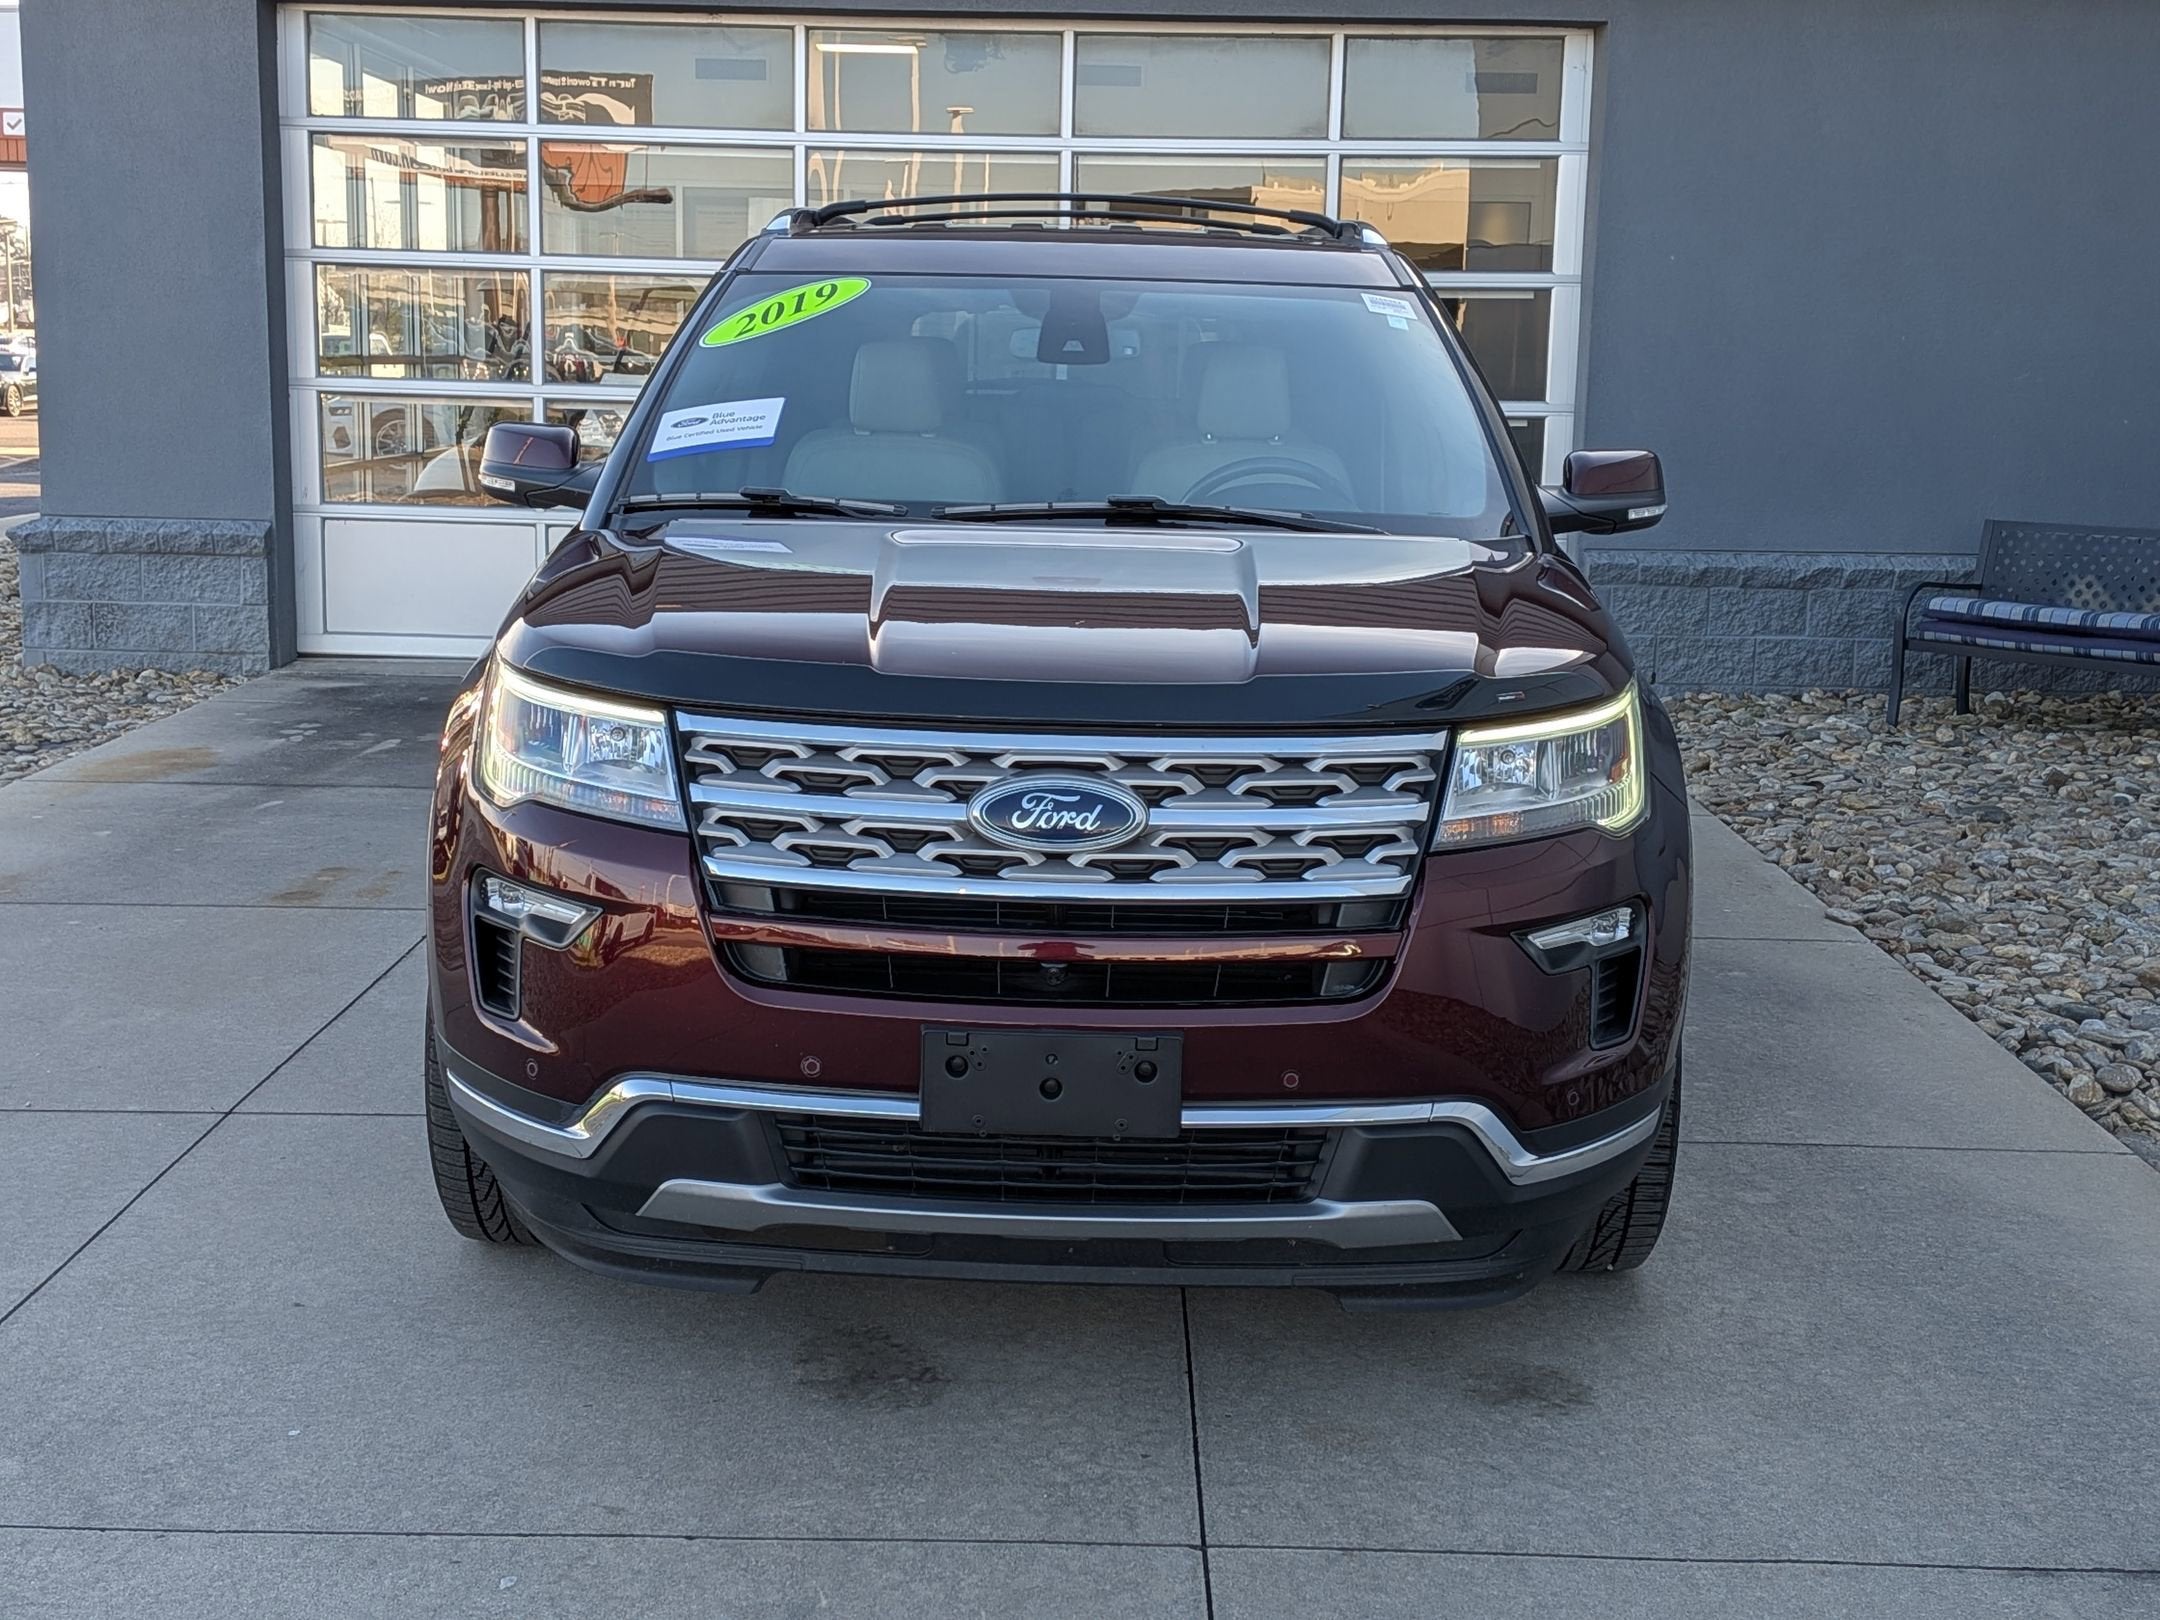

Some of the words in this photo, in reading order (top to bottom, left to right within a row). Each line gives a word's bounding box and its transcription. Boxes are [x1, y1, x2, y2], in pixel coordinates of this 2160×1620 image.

[734, 283, 839, 339] 2019
[709, 415, 766, 426] Advantage
[712, 411, 736, 419] Blue
[684, 429, 715, 438] Certified
[1011, 792, 1103, 831] Ford
